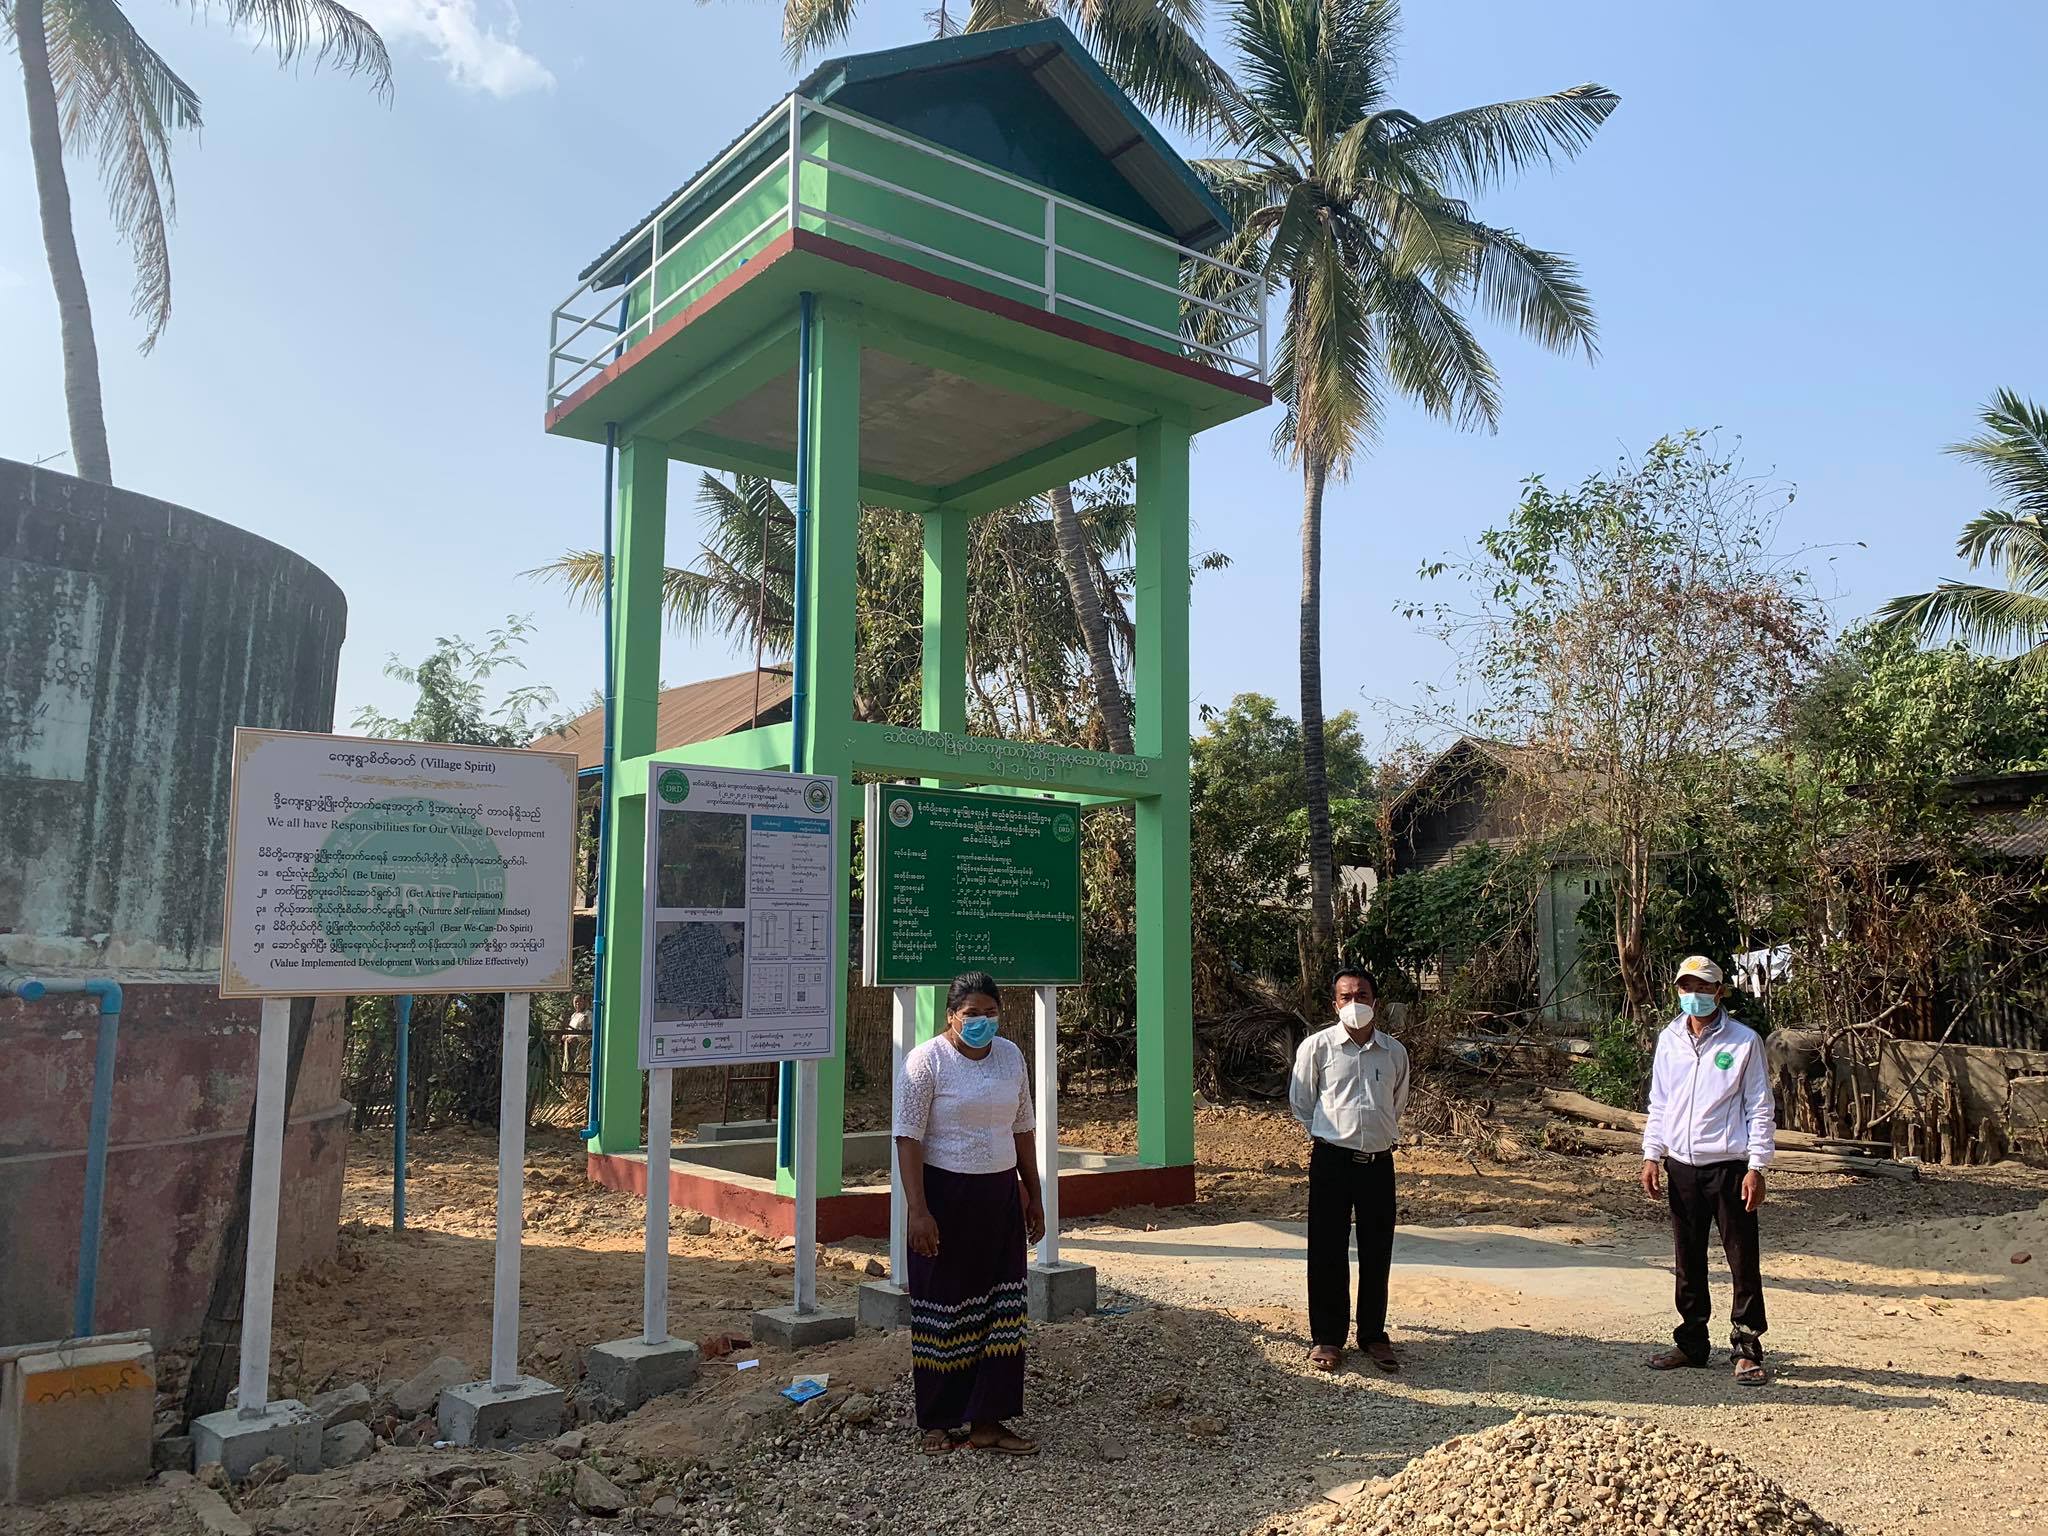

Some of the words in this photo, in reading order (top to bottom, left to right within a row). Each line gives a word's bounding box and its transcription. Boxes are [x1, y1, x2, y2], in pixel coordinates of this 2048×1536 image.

[420, 757, 462, 773] (Village
[464, 760, 496, 775] Spirit)
[665, 784, 683, 793] DRD
[267, 816, 285, 828] We
[286, 817, 301, 829] all
[303, 818, 328, 829] have
[331, 820, 410, 833] Responsibilities
[412, 824, 426, 834] for
[429, 825, 448, 834] Our
[451, 825, 483, 837] Village
[486, 827, 546, 840] Development
[352, 871, 369, 881] (Be
[371, 872, 396, 881] Unite)
[405, 890, 425, 899] (Get
[425, 890, 451, 899] Active
[452, 891, 503, 901] Participation)
[418, 906, 452, 916] (Nurture
[454, 906, 496, 916] Self-reliant
[497, 907, 531, 917] Mindset)
[440, 923, 462, 933] (Bear
[464, 923, 509, 932] We-Can-Do
[509, 924, 533, 933] Spirit)
[269, 958, 299, 970] (Value
[301, 958, 356, 969] Implemented
[358, 957, 412, 969] Development
[415, 958, 440, 966] Works
[441, 958, 455, 966] and
[457, 957, 484, 966] Utilize
[484, 957, 529, 967] Effectively)
